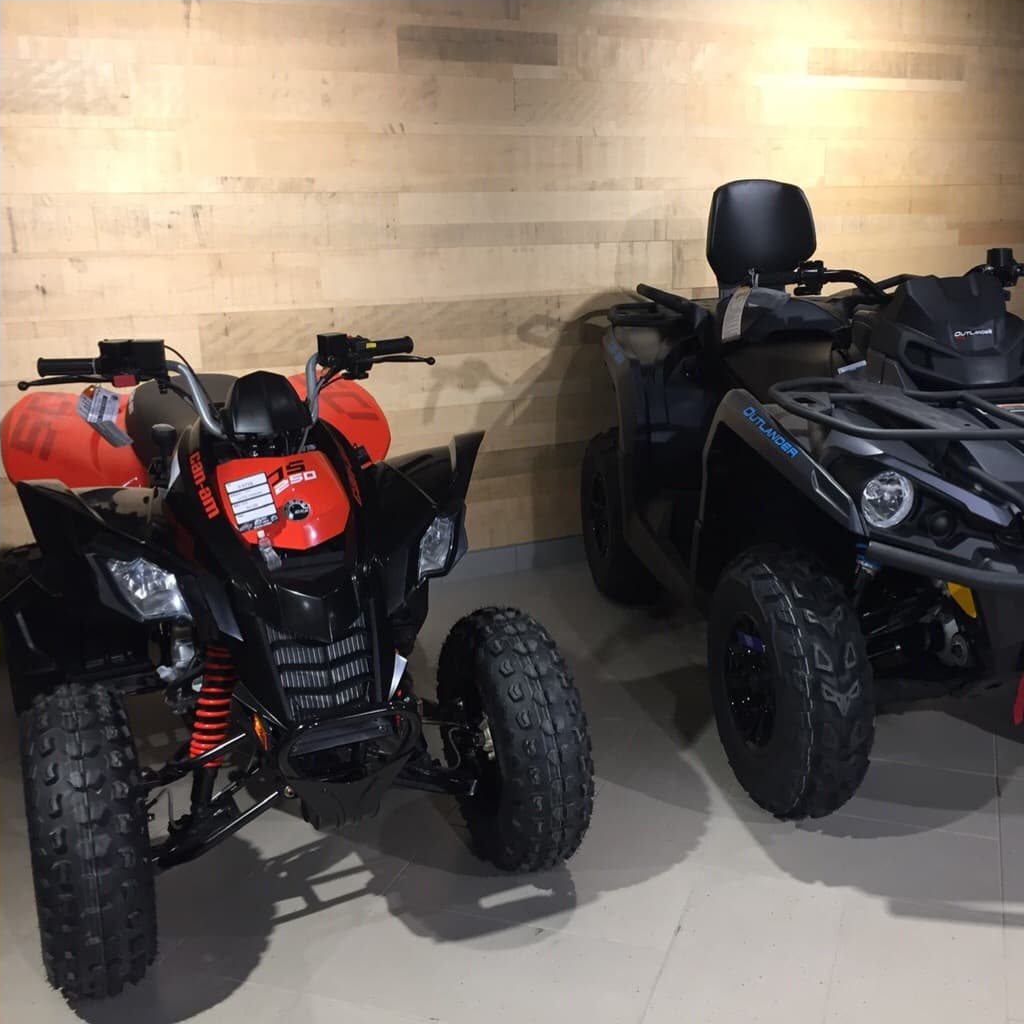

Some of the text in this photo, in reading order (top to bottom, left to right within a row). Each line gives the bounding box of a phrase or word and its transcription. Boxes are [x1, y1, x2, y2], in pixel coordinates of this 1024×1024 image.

[743, 406, 799, 458] OUTLANDER
[189, 451, 220, 520] can-am
[274, 470, 318, 496] 250
